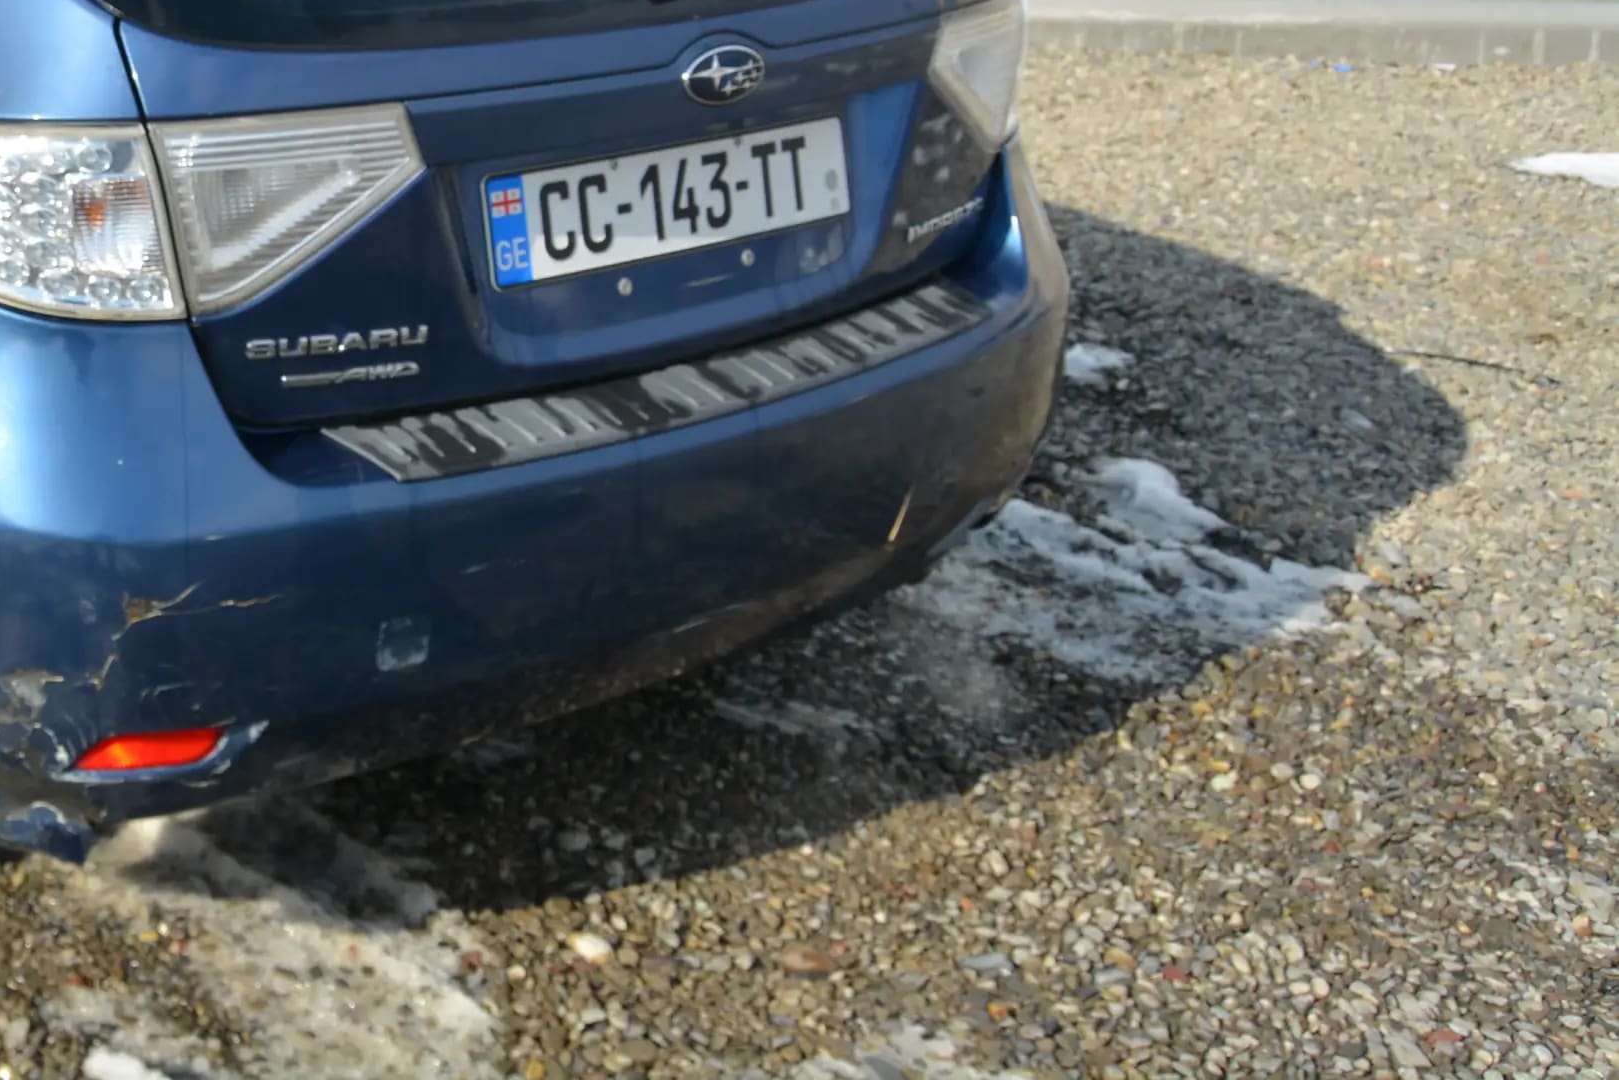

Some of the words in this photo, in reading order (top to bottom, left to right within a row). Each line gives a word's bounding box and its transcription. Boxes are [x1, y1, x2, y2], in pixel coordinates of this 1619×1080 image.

[539, 135, 806, 262] CC-143-TT
[495, 236, 530, 272] GE
[245, 324, 429, 360] SUBARU
[333, 361, 421, 384] AWD
